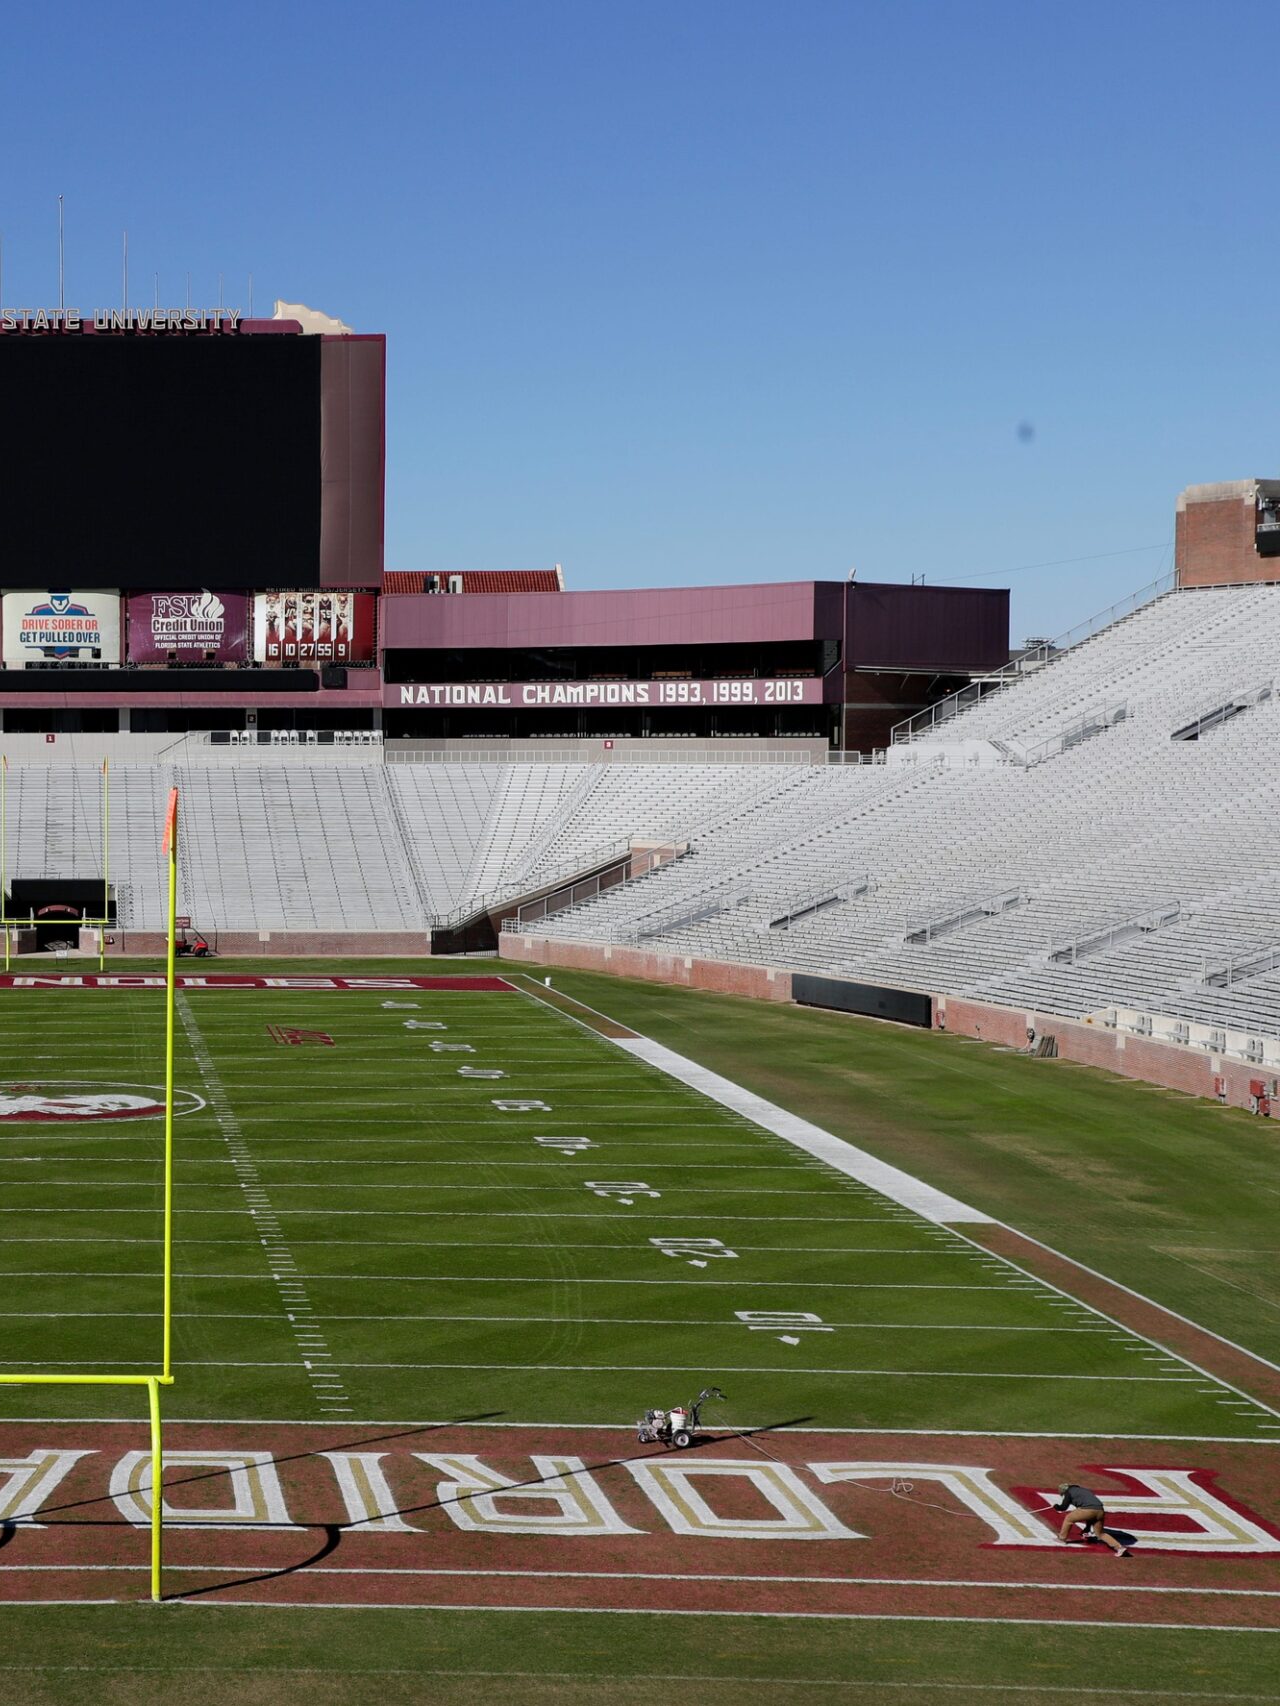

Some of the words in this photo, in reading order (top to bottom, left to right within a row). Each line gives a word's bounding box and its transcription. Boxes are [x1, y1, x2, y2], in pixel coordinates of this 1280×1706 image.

[1, 308, 80, 330] STATE
[94, 308, 241, 330] UNIVERSITY
[151, 595, 202, 619] FSU
[21, 618, 50, 631] DRIVE
[51, 618, 83, 631] SOBER
[84, 618, 98, 631] OR
[152, 619, 188, 632] Credit
[190, 619, 223, 632] Union
[20, 631, 38, 643] GET
[39, 631, 76, 643] PULLED
[76, 631, 100, 643] OVER
[154, 633, 177, 641] OFFICIAL
[177, 633, 197, 641] CREDIT
[197, 633, 214, 641] UNION
[215, 633, 222, 641] OF
[154, 641, 177, 649] FLORIDA
[177, 641, 193, 649] STATE
[193, 641, 221, 649] ATHLETICS
[268, 643, 279, 657] 16
[285, 643, 296, 657] 10
[300, 643, 315, 657] 27
[317, 643, 332, 657] 55
[338, 643, 346, 657] 9
[400, 685, 511, 705] NATIONAL
[522, 683, 650, 705] CHAMPIONS
[659, 683, 706, 705] 1993,
[713, 682, 758, 704] 1999,
[764, 681, 804, 702] 2013
[584, 1181, 662, 1198] 30
[648, 1237, 739, 1259] 20
[734, 1310, 835, 1332] 10
